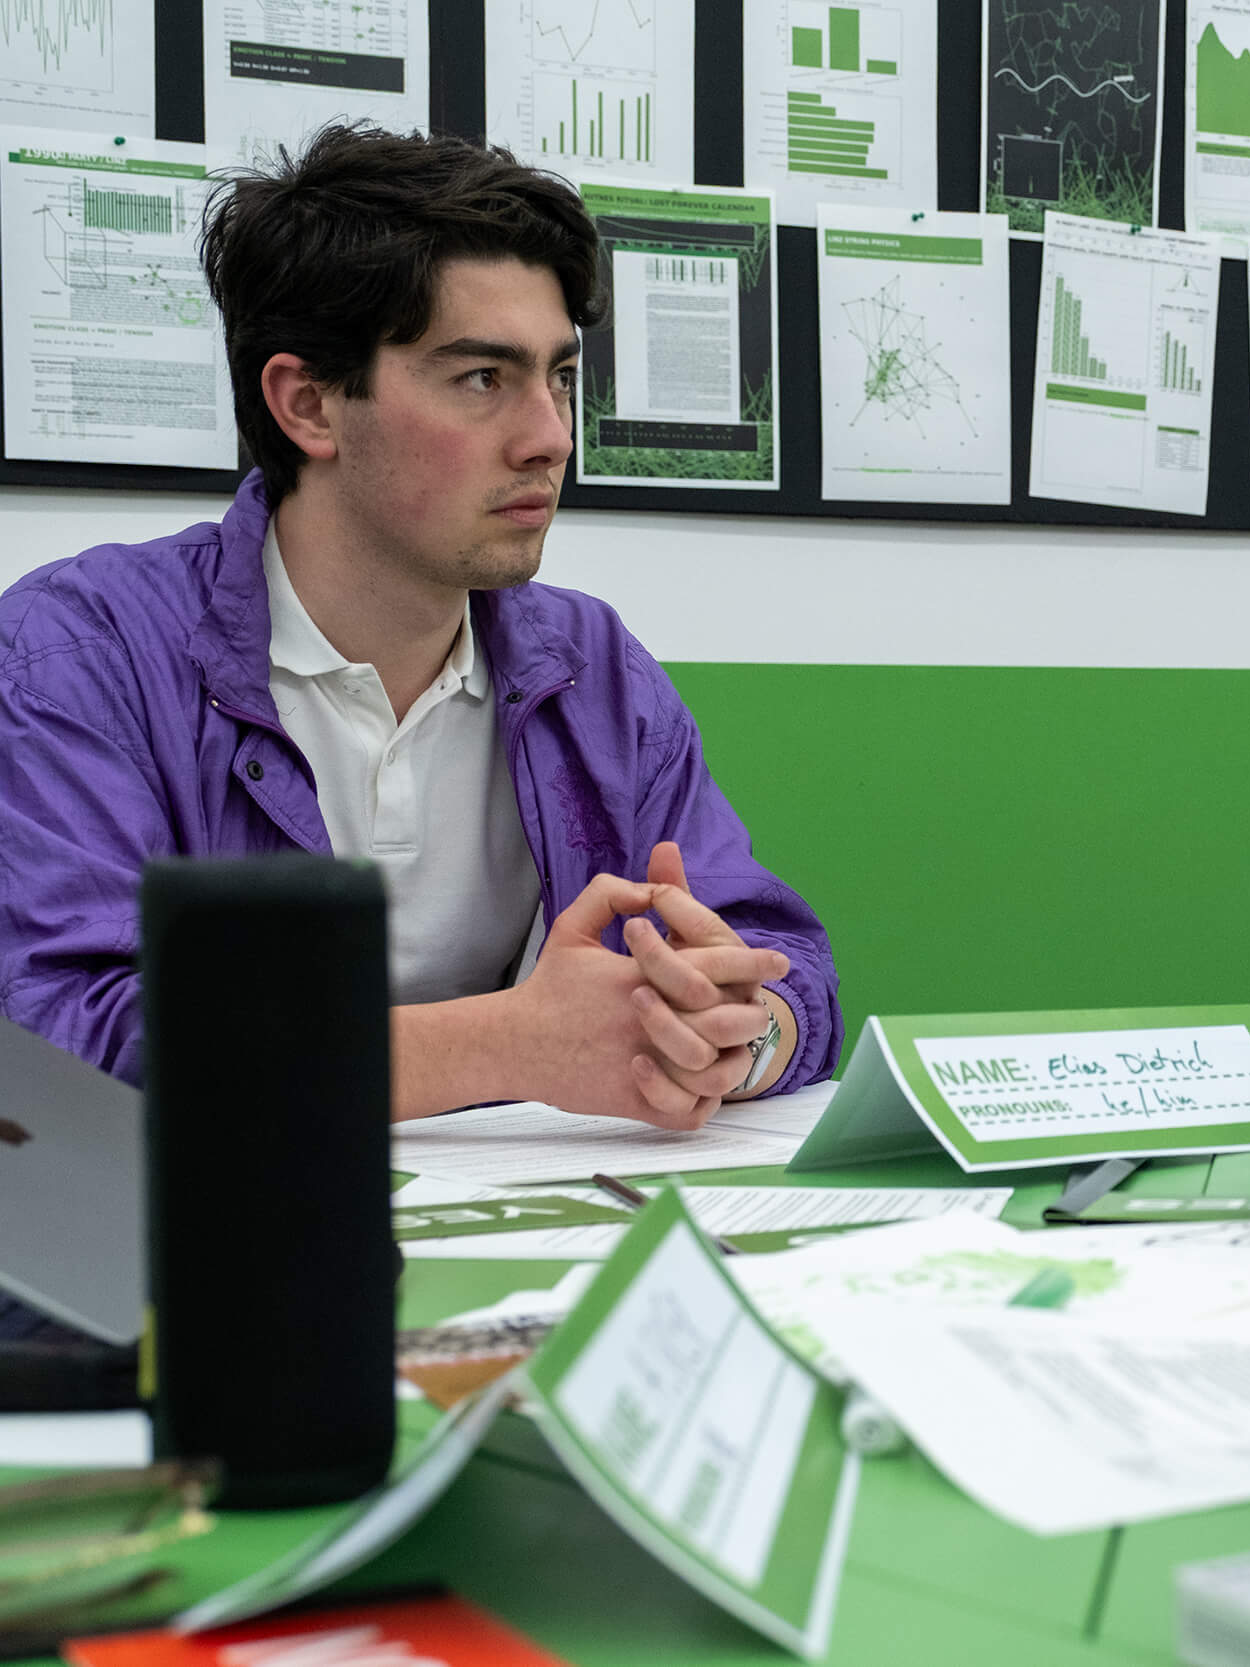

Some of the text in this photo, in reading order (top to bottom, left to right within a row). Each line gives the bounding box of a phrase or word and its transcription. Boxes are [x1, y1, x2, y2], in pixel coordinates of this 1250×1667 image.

[711, 202, 756, 212] CALENDAR
[932, 1040, 1214, 1087] NAME: Elias Dietrich
[958, 1099, 1073, 1120] PRONOUNS:
